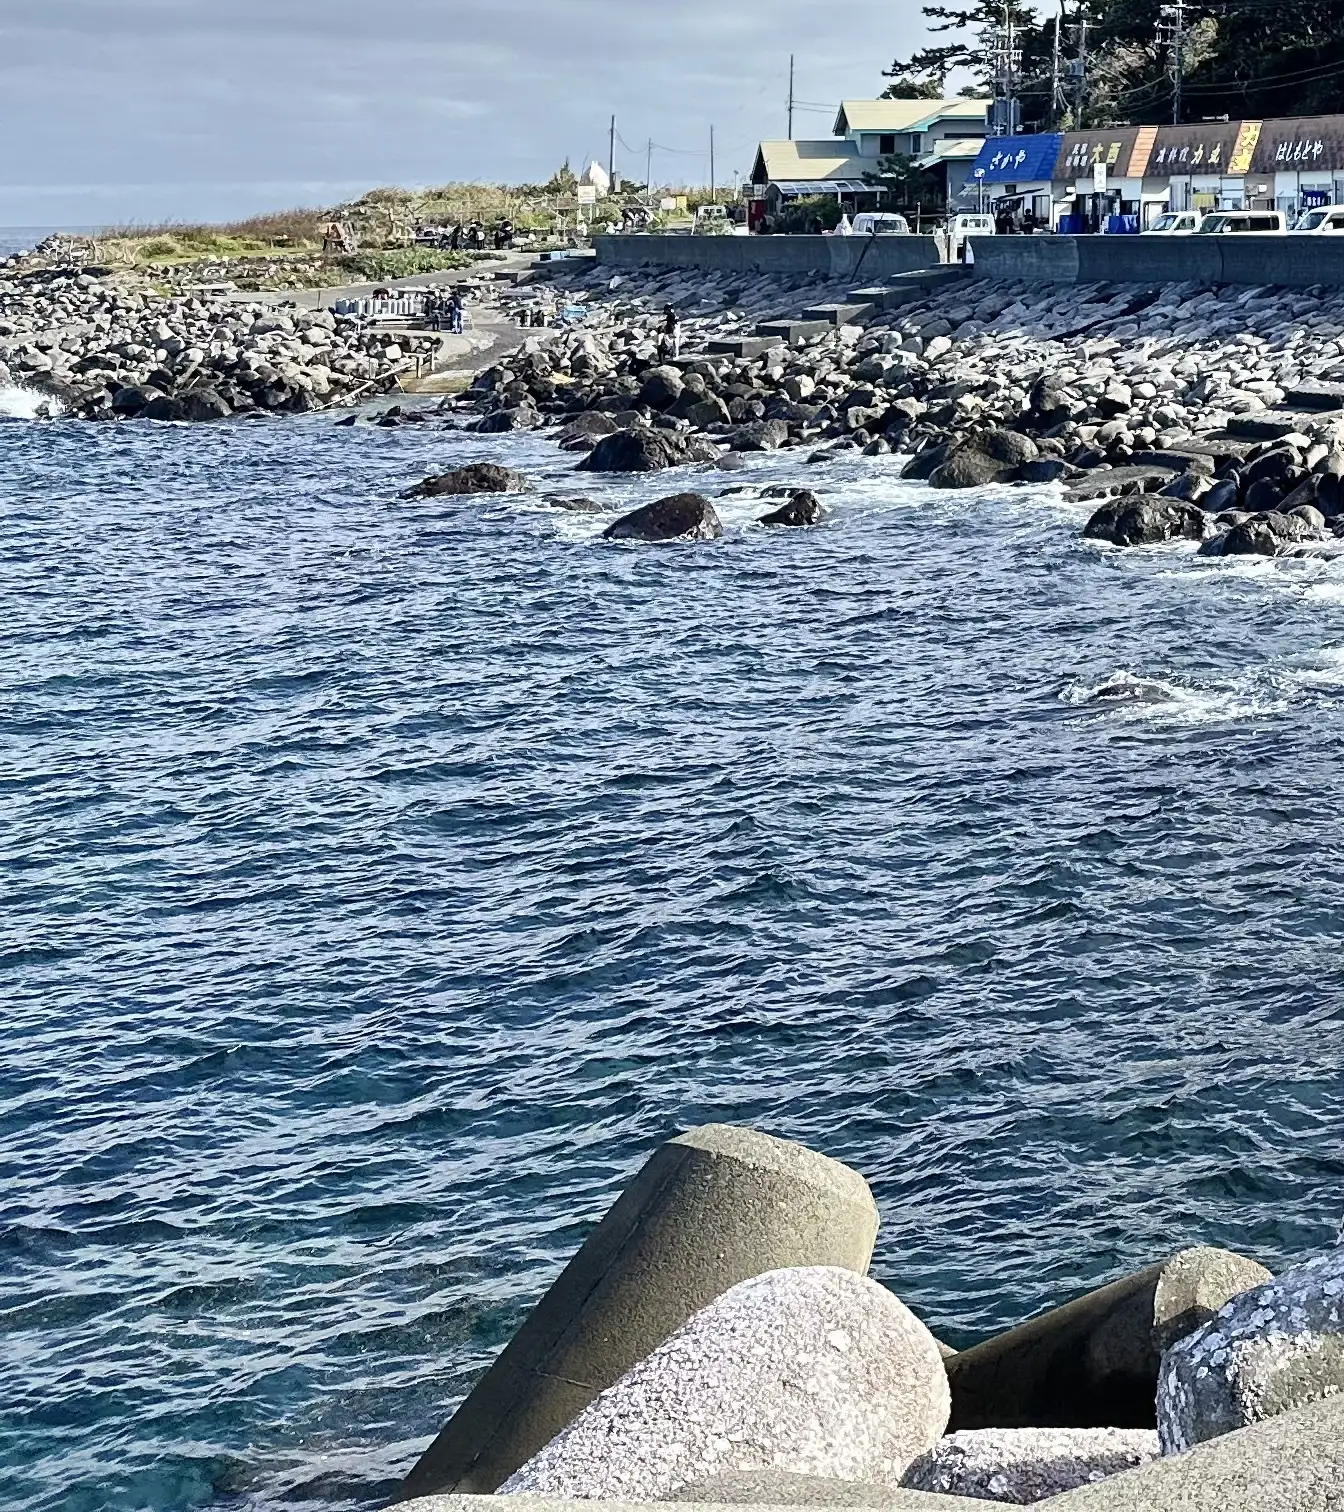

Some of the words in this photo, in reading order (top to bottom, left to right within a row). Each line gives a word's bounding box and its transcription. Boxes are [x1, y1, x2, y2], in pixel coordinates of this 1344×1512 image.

[1276, 139, 1324, 162] はしもとや
